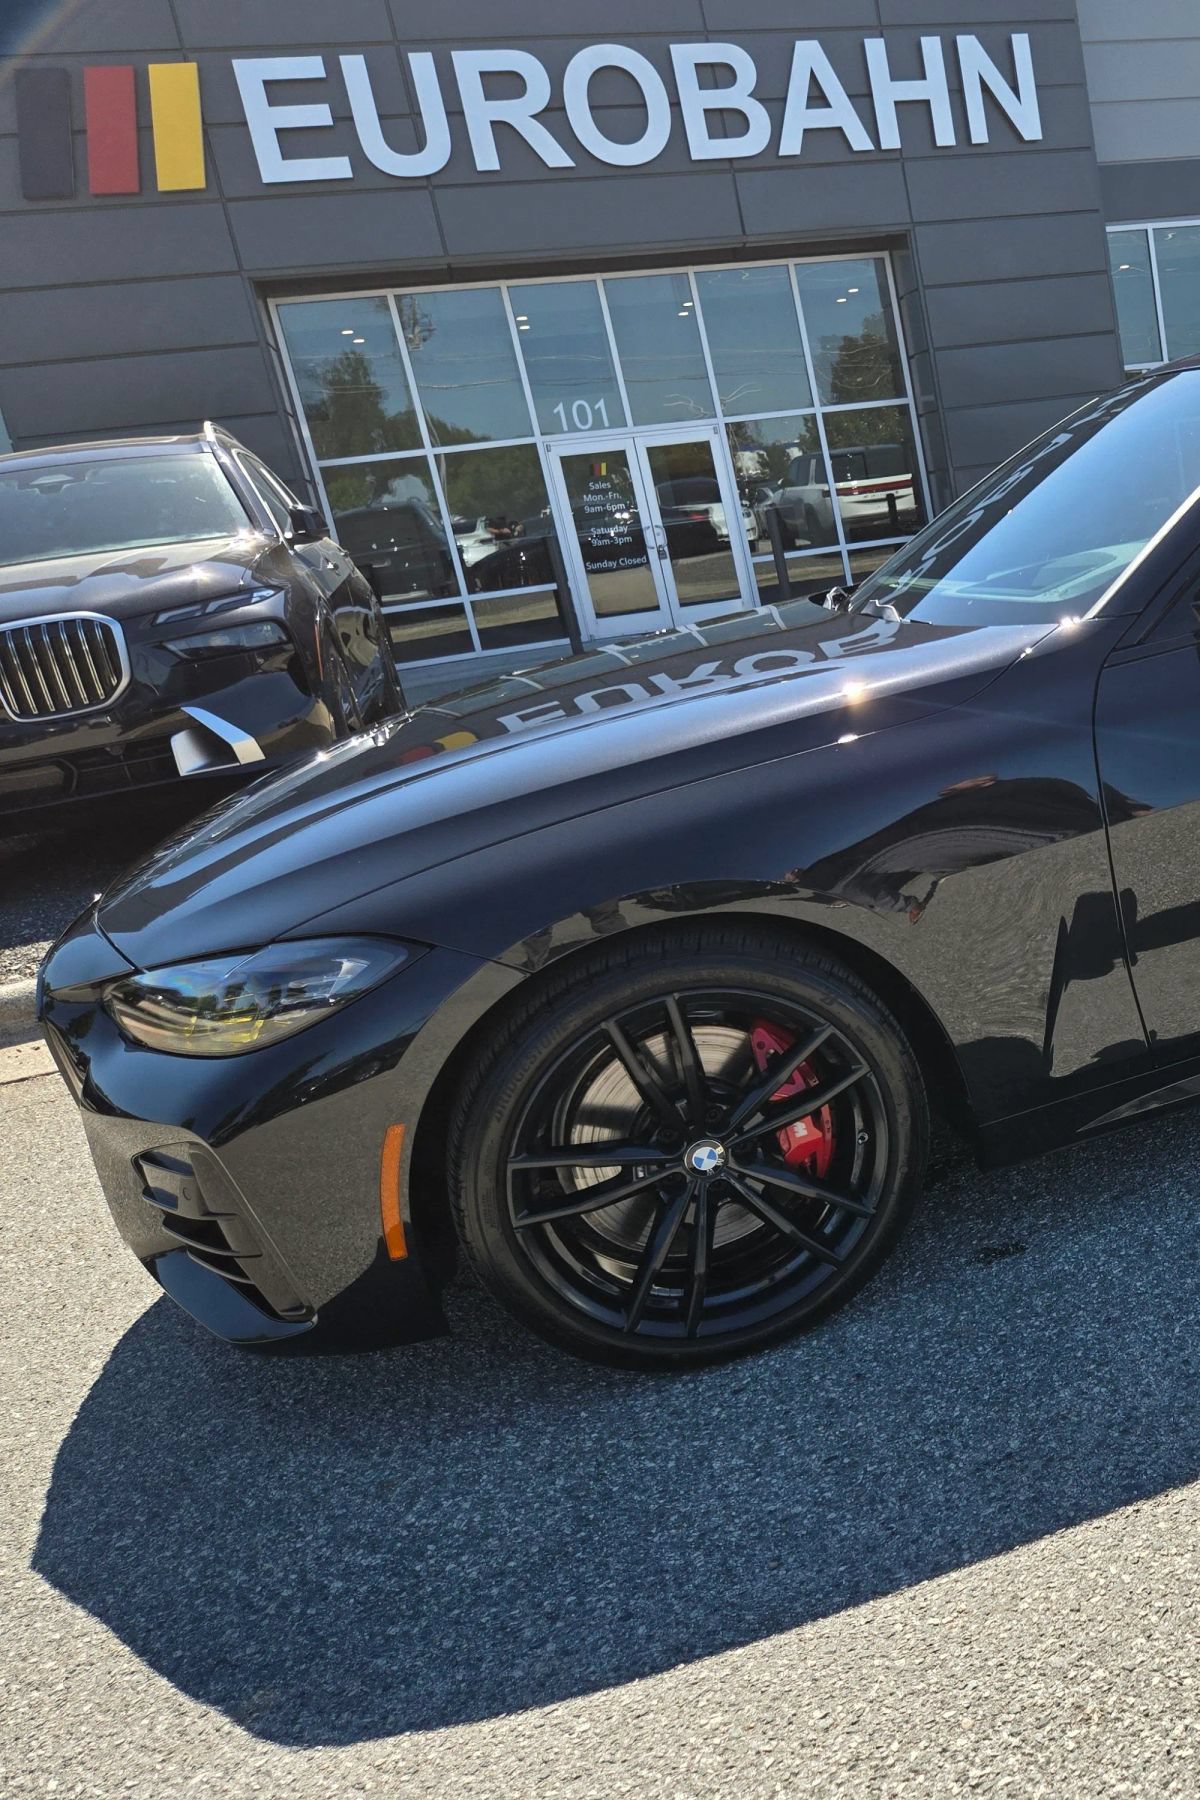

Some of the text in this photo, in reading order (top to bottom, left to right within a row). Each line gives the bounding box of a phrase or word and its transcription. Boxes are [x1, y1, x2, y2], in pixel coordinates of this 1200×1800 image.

[231, 33, 1043, 184] EUROBAHN
[553, 398, 609, 432] 101
[588, 481, 611, 490] Sales
[584, 503, 626, 514] 9am-6pm
[590, 524, 628, 535] Saturday
[591, 536, 633, 547] 9am-3pm
[585, 555, 647, 570] Sunday Closed
